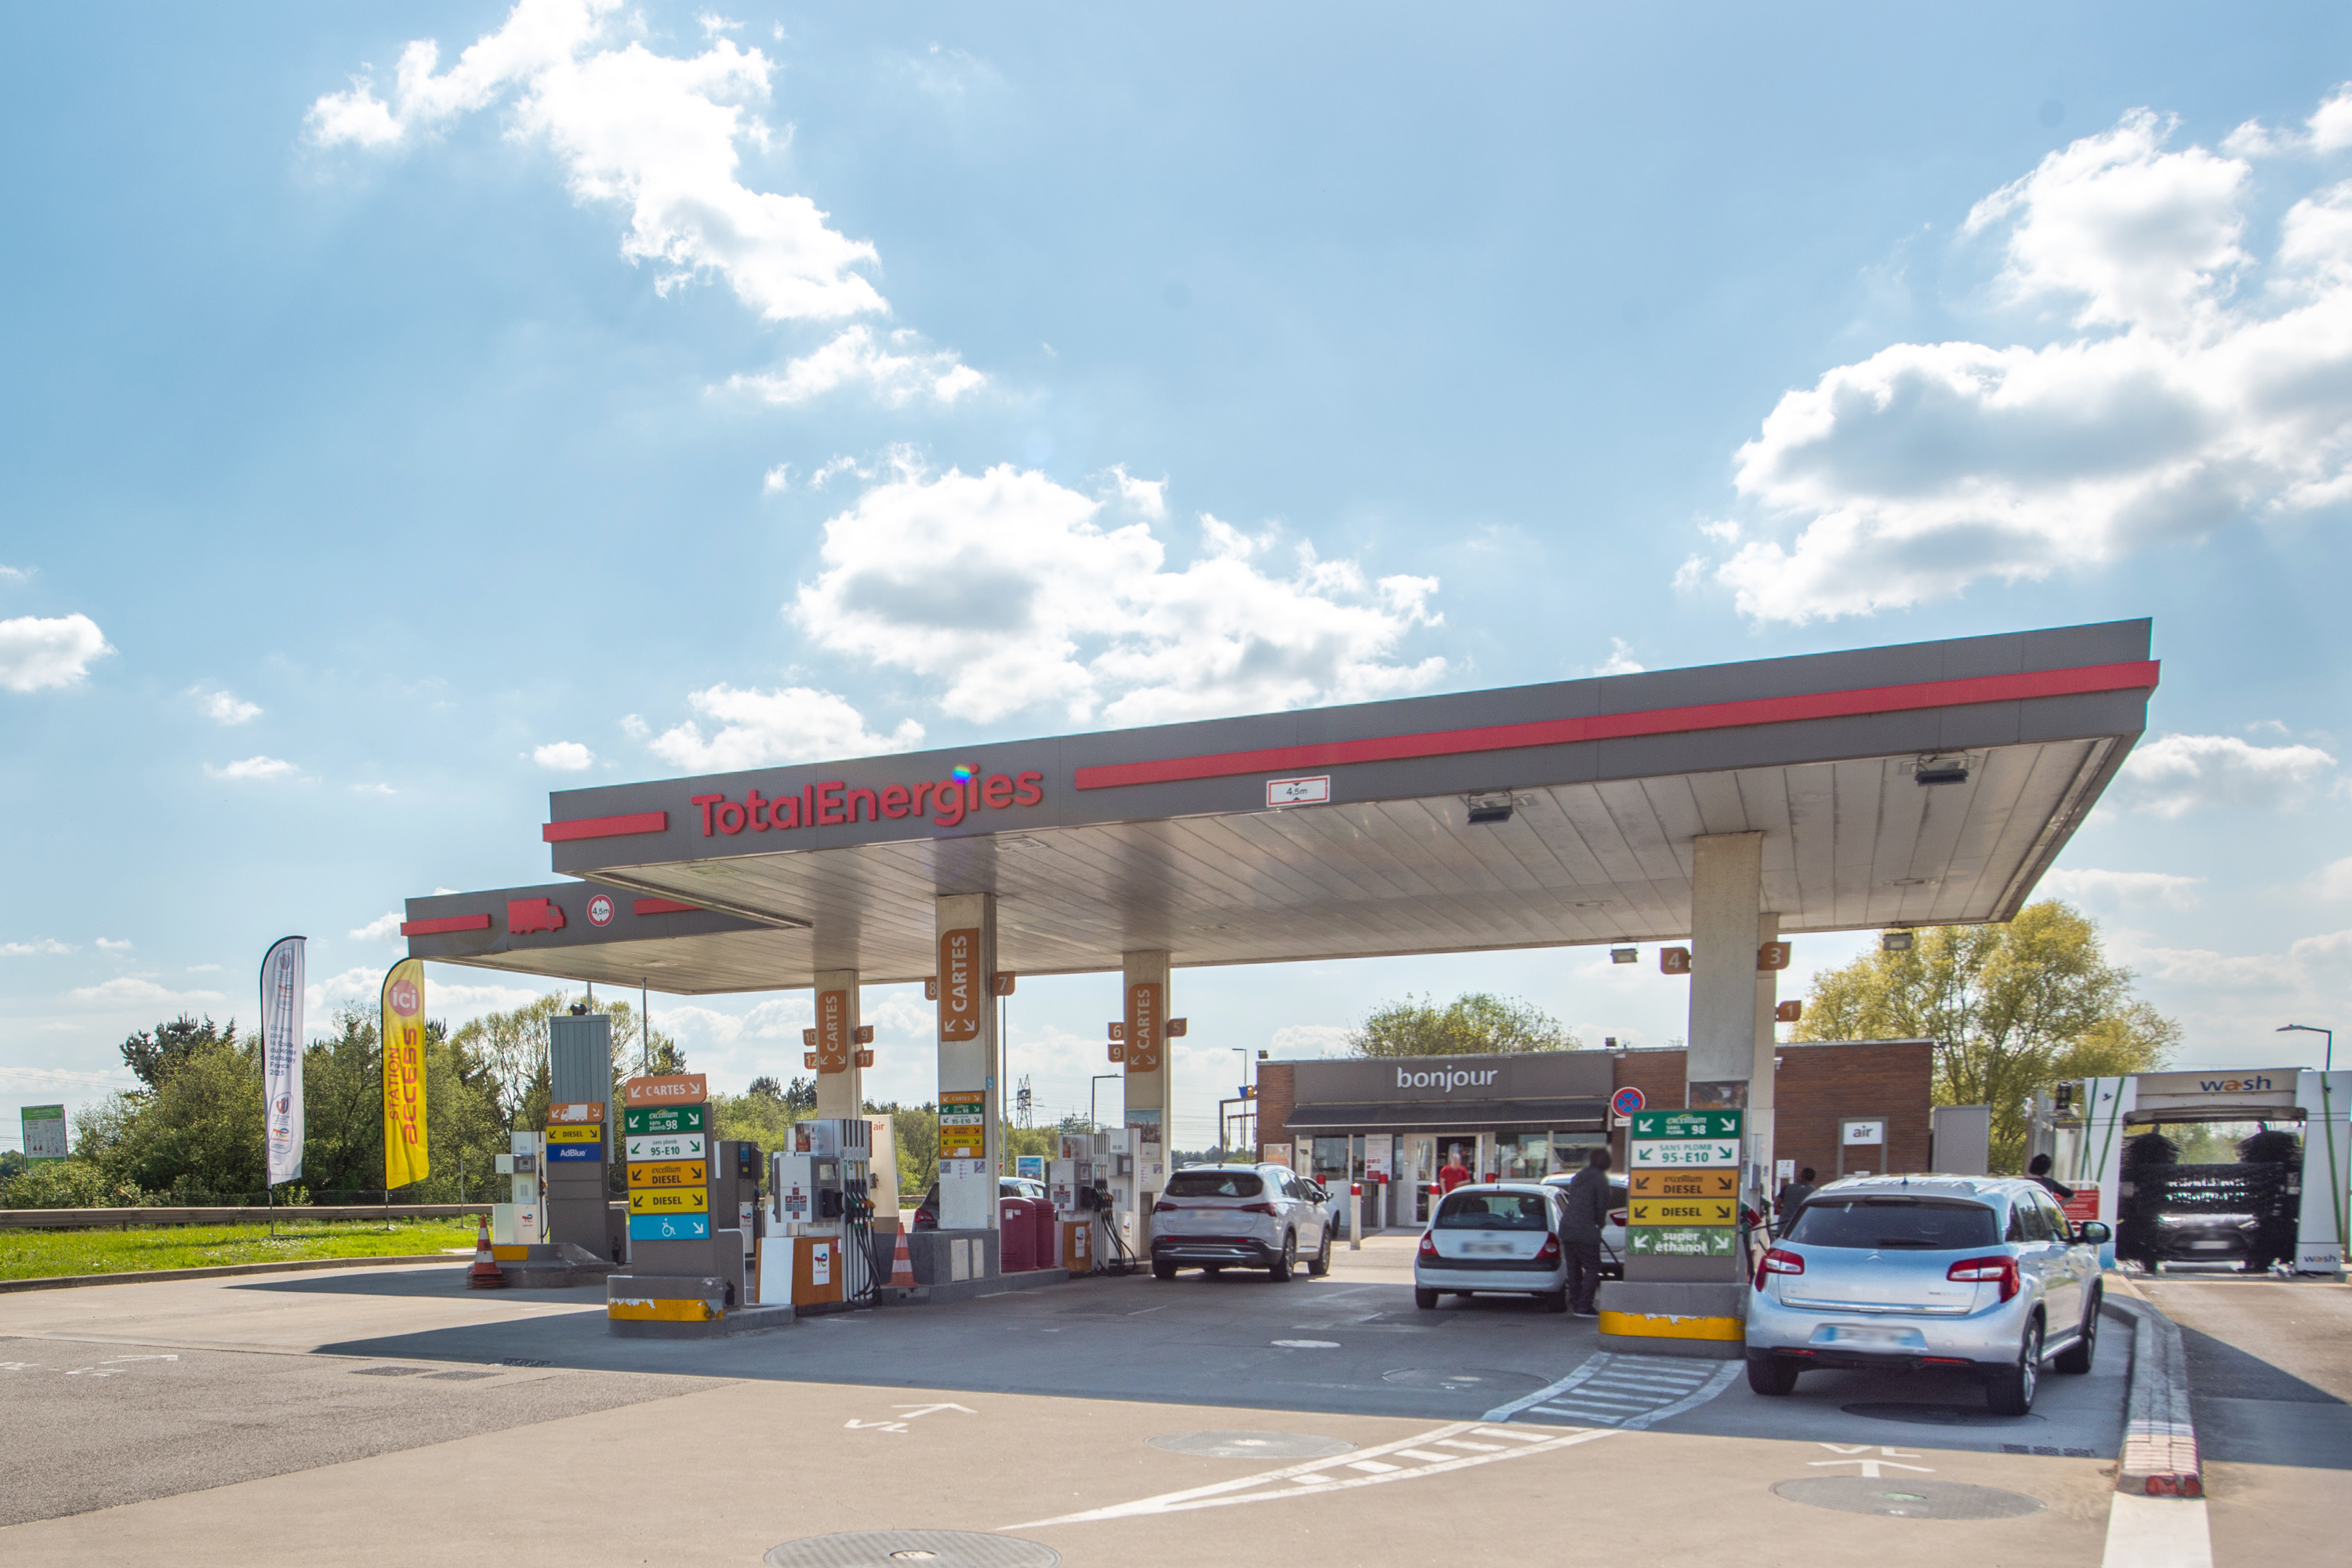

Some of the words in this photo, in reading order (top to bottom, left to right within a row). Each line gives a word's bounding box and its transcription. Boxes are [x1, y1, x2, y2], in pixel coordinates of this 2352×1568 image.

[1286, 787, 1308, 797] 4,5m
[691, 764, 1044, 837] TotalEnergies
[592, 907, 610, 916] 4,5m
[1668, 952, 1681, 969] 4
[1769, 947, 1782, 964] 3
[951, 935, 967, 1012] CARTES
[929, 982, 936, 996] 8
[998, 976, 1007, 991] 7
[393, 987, 416, 1009] ici
[1787, 1005, 1793, 1018] 1
[826, 995, 838, 1052] CARTES
[1136, 989, 1150, 1050] CARTES
[1113, 1025, 1122, 1038] 6
[1173, 1022, 1181, 1033] 5
[804, 1032, 816, 1043] 10
[862, 1029, 869, 1040] 9
[859, 1053, 870, 1065] 11
[1113, 1047, 1121, 1059] 9
[805, 1054, 816, 1067] 12
[388, 1047, 400, 1120] STATION
[1397, 1065, 1499, 1093] bonjour
[2199, 1075, 2272, 1091] wash
[645, 1084, 686, 1096] CARTES
[648, 1110, 678, 1120] excellium
[1666, 1116, 1707, 1124] excellium
[666, 1120, 678, 1131] 98
[873, 1121, 885, 1131] air
[1691, 1125, 1707, 1135] 98
[1853, 1125, 1874, 1138] air
[651, 1146, 681, 1156] 95-E10
[1661, 1152, 1709, 1163] 95-E10
[652, 1165, 681, 1174] excellium
[652, 1174, 682, 1184] DIESEL
[1663, 1185, 1703, 1194] DIESEL
[652, 1196, 683, 1206] DIESEL
[1661, 1207, 1702, 1216] DIESEL
[1662, 1232, 1700, 1243] super
[1655, 1240, 1705, 1252] éthanol
